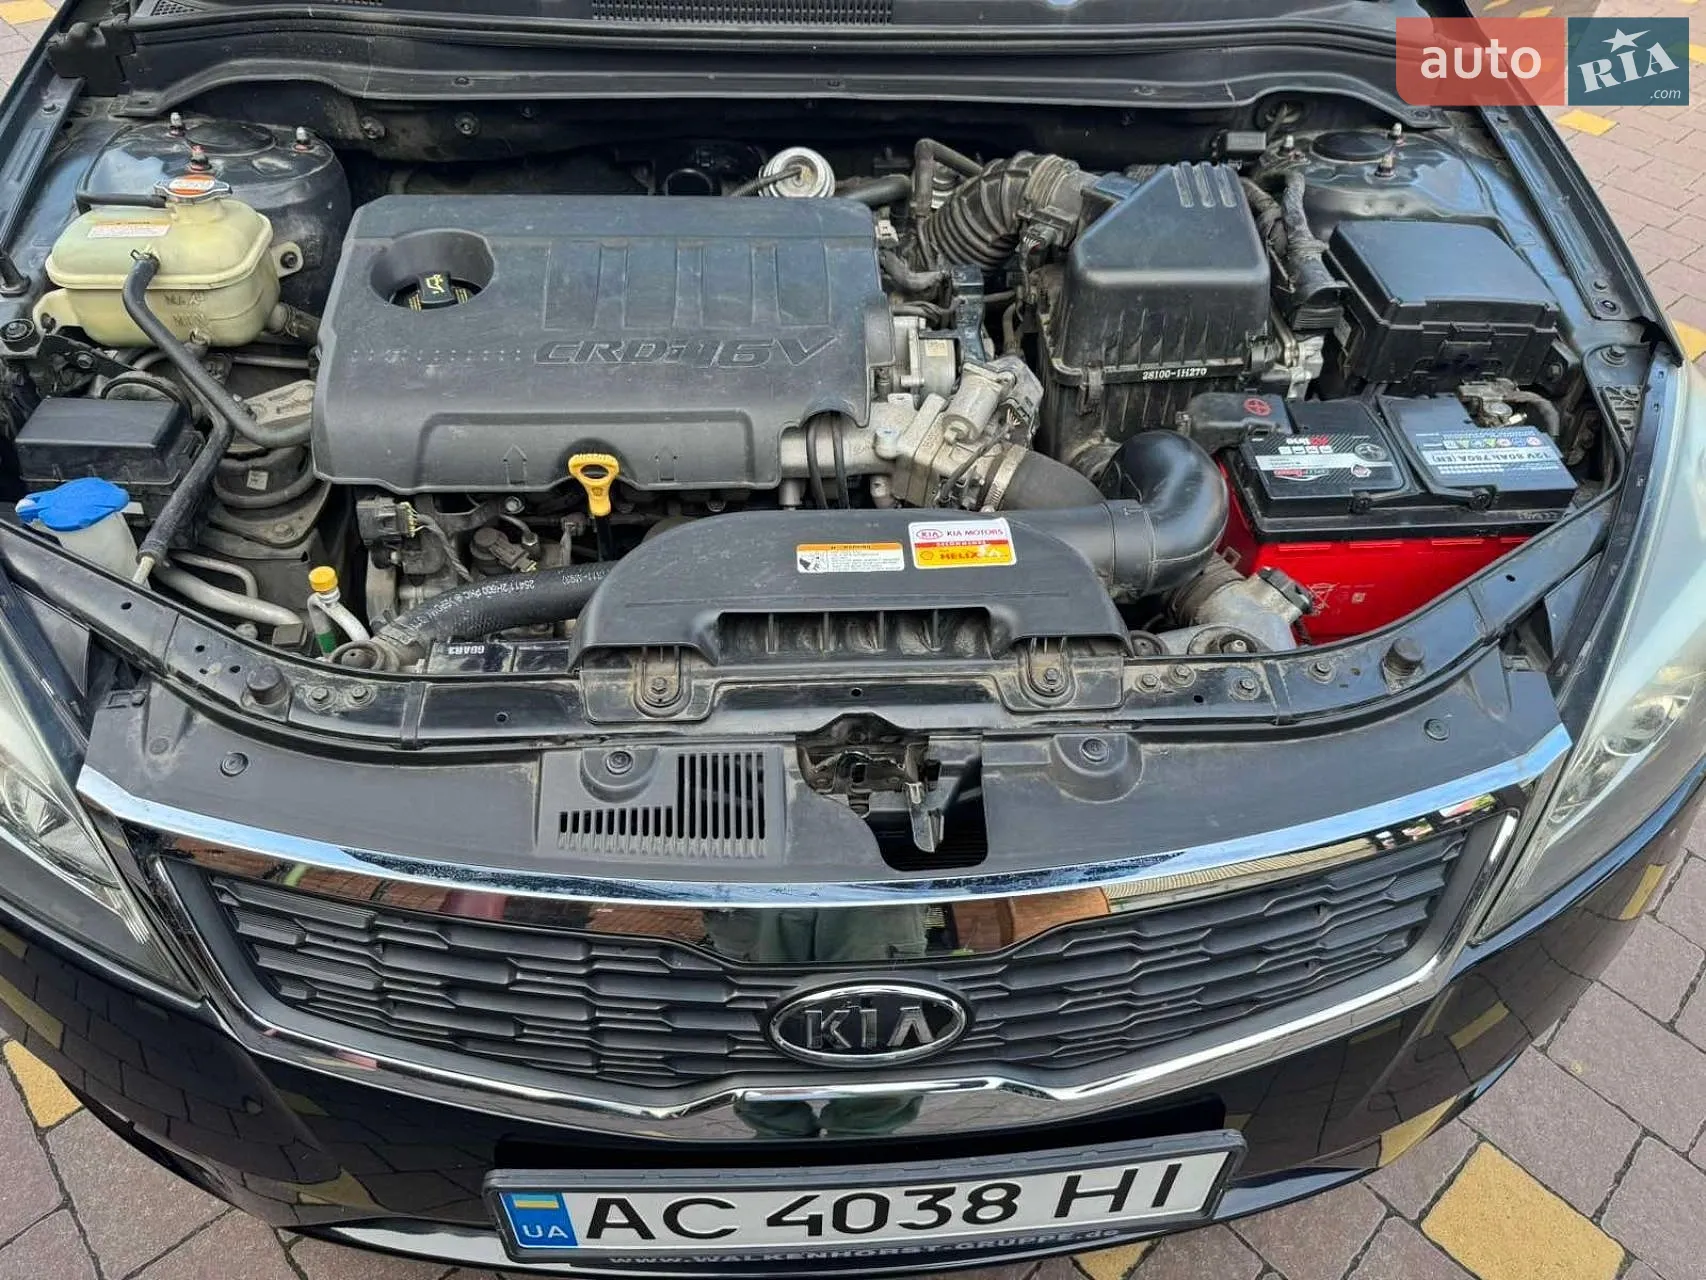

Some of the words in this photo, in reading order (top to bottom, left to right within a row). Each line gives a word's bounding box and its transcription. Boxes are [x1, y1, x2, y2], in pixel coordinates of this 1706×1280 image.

[1142, 368, 1208, 380] 28100-1H270
[804, 1006, 935, 1049] KIA
[585, 1196, 738, 1240] AC
[766, 1182, 1022, 1237] 4038
[1053, 1163, 1183, 1219] HI
[521, 1224, 569, 1240] UA
